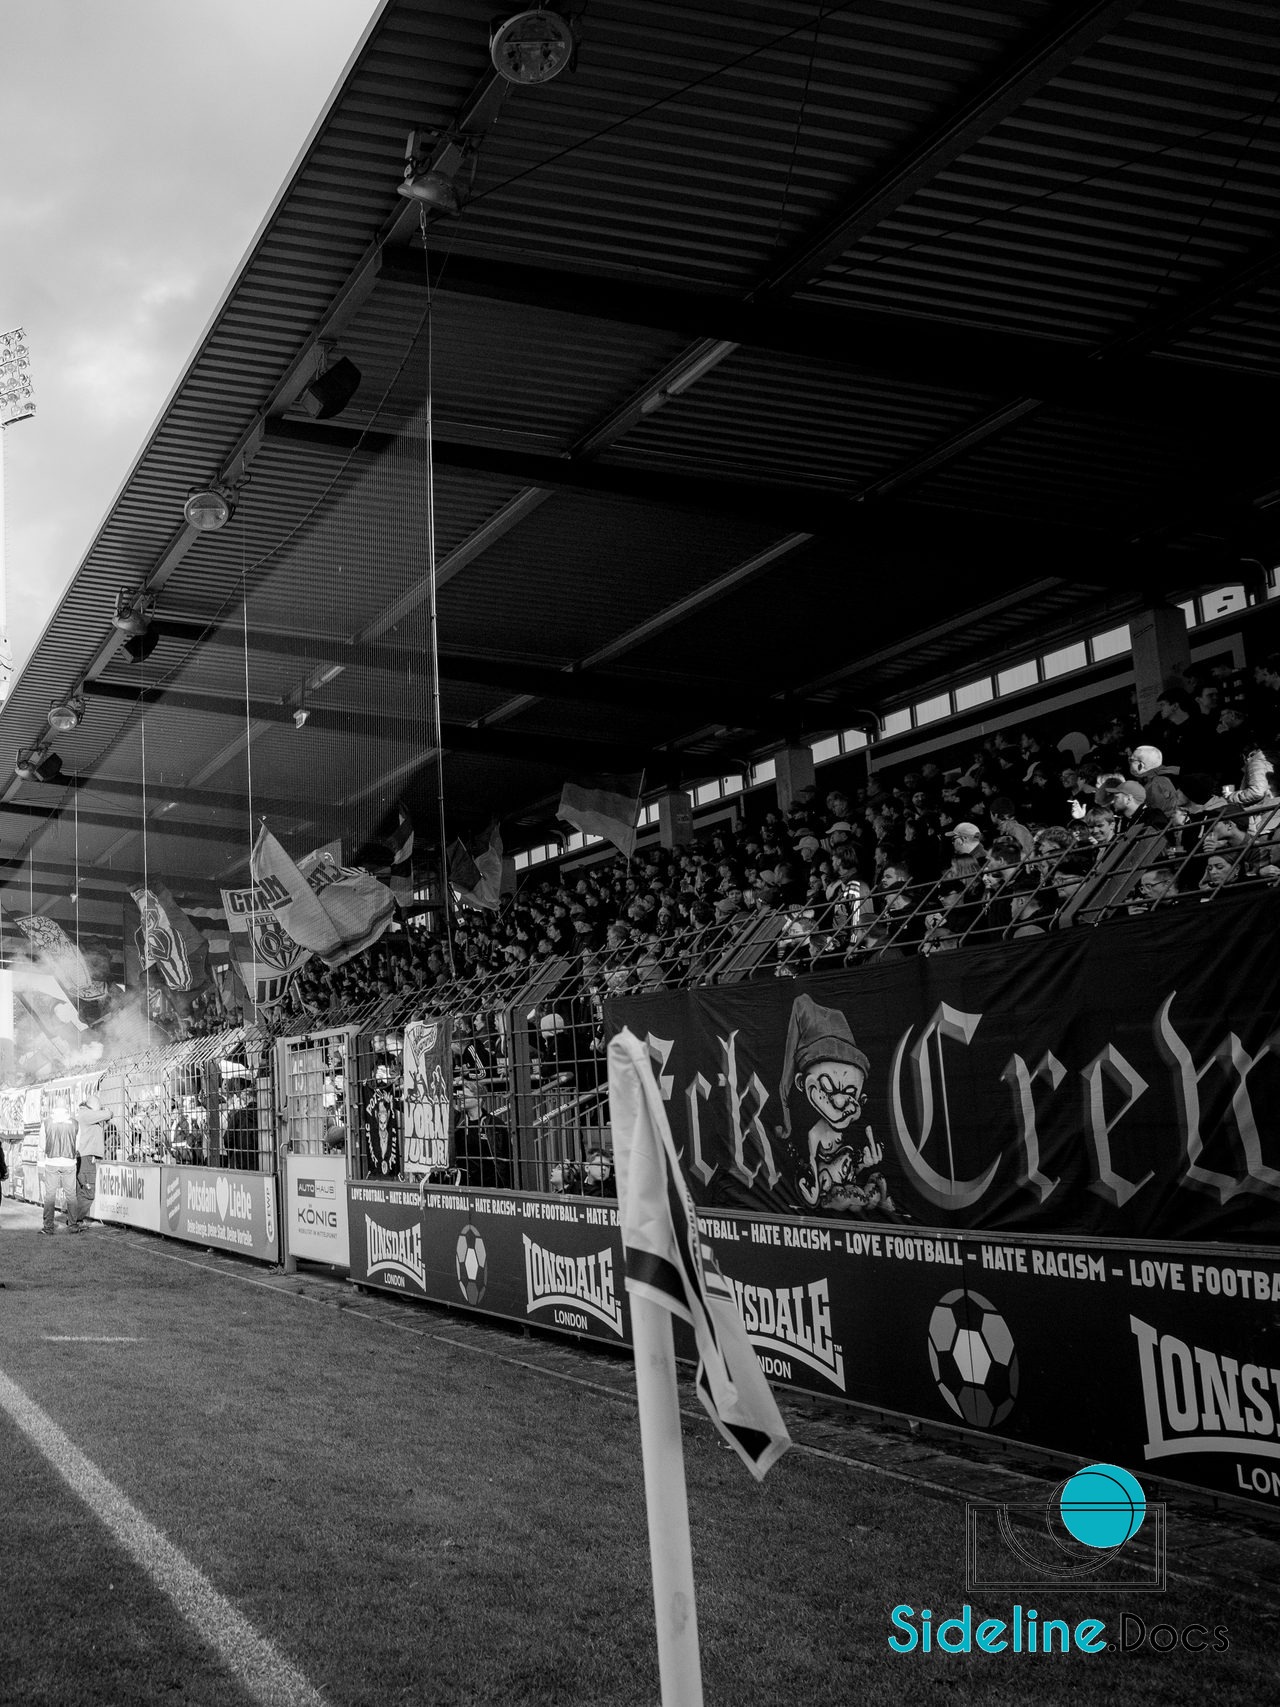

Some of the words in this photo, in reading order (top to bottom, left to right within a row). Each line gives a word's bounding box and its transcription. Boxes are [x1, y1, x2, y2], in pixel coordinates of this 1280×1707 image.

[187, 1180, 216, 1213] Potsdam
[229, 1183, 252, 1220] Liebe
[298, 1203, 337, 1227] KÖNIG
[351, 1187, 362, 1200] LOVE
[363, 1188, 385, 1203] FOOTBALL
[389, 1190, 402, 1205] HATE
[403, 1191, 421, 1206] RACISM
[427, 1194, 441, 1209] LOVE
[441, 1195, 469, 1211] FOOTBALL
[475, 1197, 491, 1214] HATE
[492, 1199, 517, 1216] RACISM
[522, 1202, 540, 1219] LOVE
[541, 1204, 579, 1223] FOOTBALL
[586, 1207, 609, 1226] HATE
[365, 1213, 424, 1280] LONSDALE
[751, 1223, 781, 1246] HATE
[783, 1227, 831, 1251] RACISM
[845, 1232, 882, 1257] LOVE
[885, 1236, 963, 1266] FOOTBALL
[981, 1244, 1028, 1273] HATE
[1032, 1250, 1106, 1282] RACISM
[1129, 1258, 1186, 1291] LOVE
[384, 1272, 405, 1288] LONDON
[522, 1232, 618, 1320] LONSDALE
[554, 1310, 588, 1330] LONDON
[757, 1355, 792, 1379] NDON
